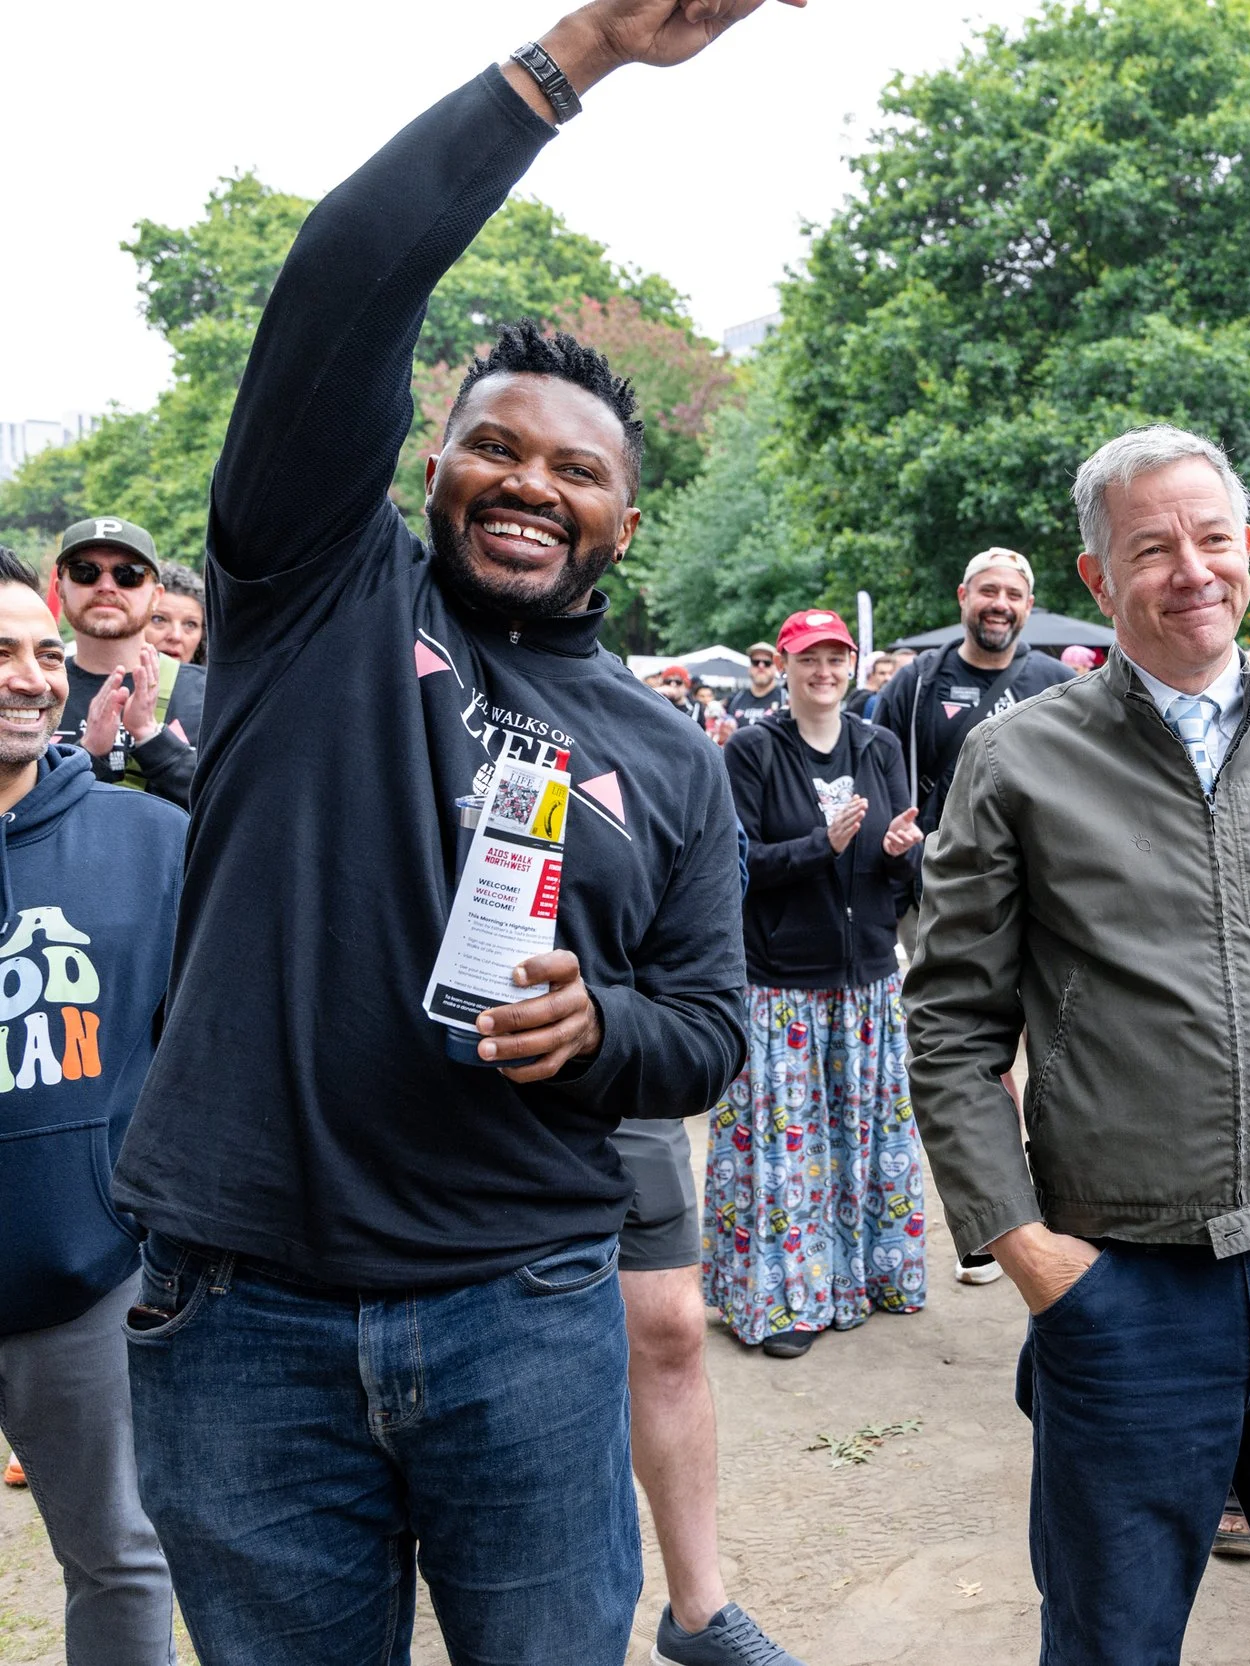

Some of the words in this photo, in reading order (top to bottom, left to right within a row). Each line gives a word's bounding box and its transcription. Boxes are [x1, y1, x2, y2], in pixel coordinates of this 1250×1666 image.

[94, 519, 122, 538] P
[491, 706, 549, 736] WALKS
[551, 729, 575, 747] OF
[509, 773, 535, 787] LIFE
[484, 855, 531, 873] NORTHWEST
[487, 847, 509, 860] AIDS
[510, 852, 534, 865] WALK
[475, 887, 519, 904] WELCOME!
[478, 878, 521, 895] WELCOME!
[473, 895, 516, 912] WELCOME!
[468, 911, 479, 919] This
[480, 916, 508, 927] Morning's
[509, 923, 536, 932] Highlights
[0, 1006, 101, 1092] AN
